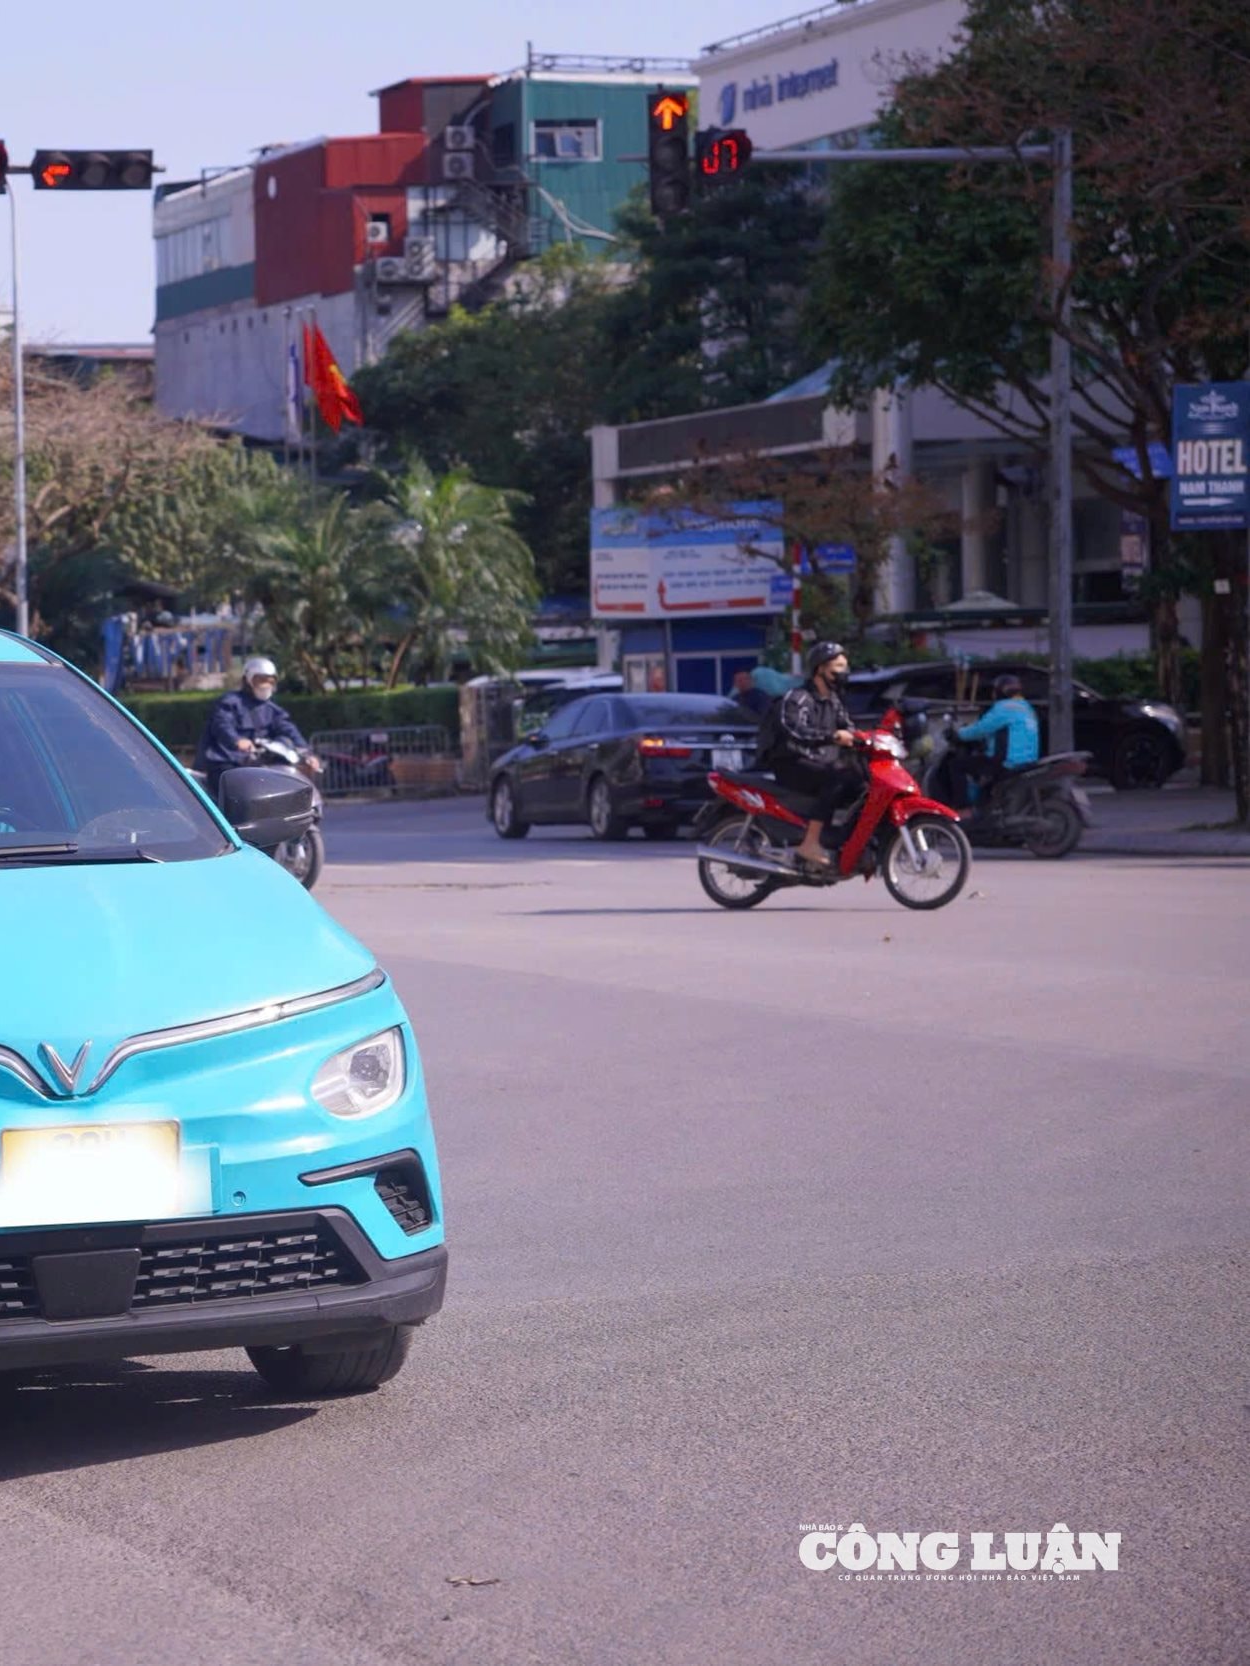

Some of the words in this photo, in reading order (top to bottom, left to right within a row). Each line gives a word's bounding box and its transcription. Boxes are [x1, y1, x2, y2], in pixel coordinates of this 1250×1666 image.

[1177, 438, 1247, 476] HOTEL
[1179, 481, 1206, 495] NAM
[1208, 480, 1244, 494] THANH
